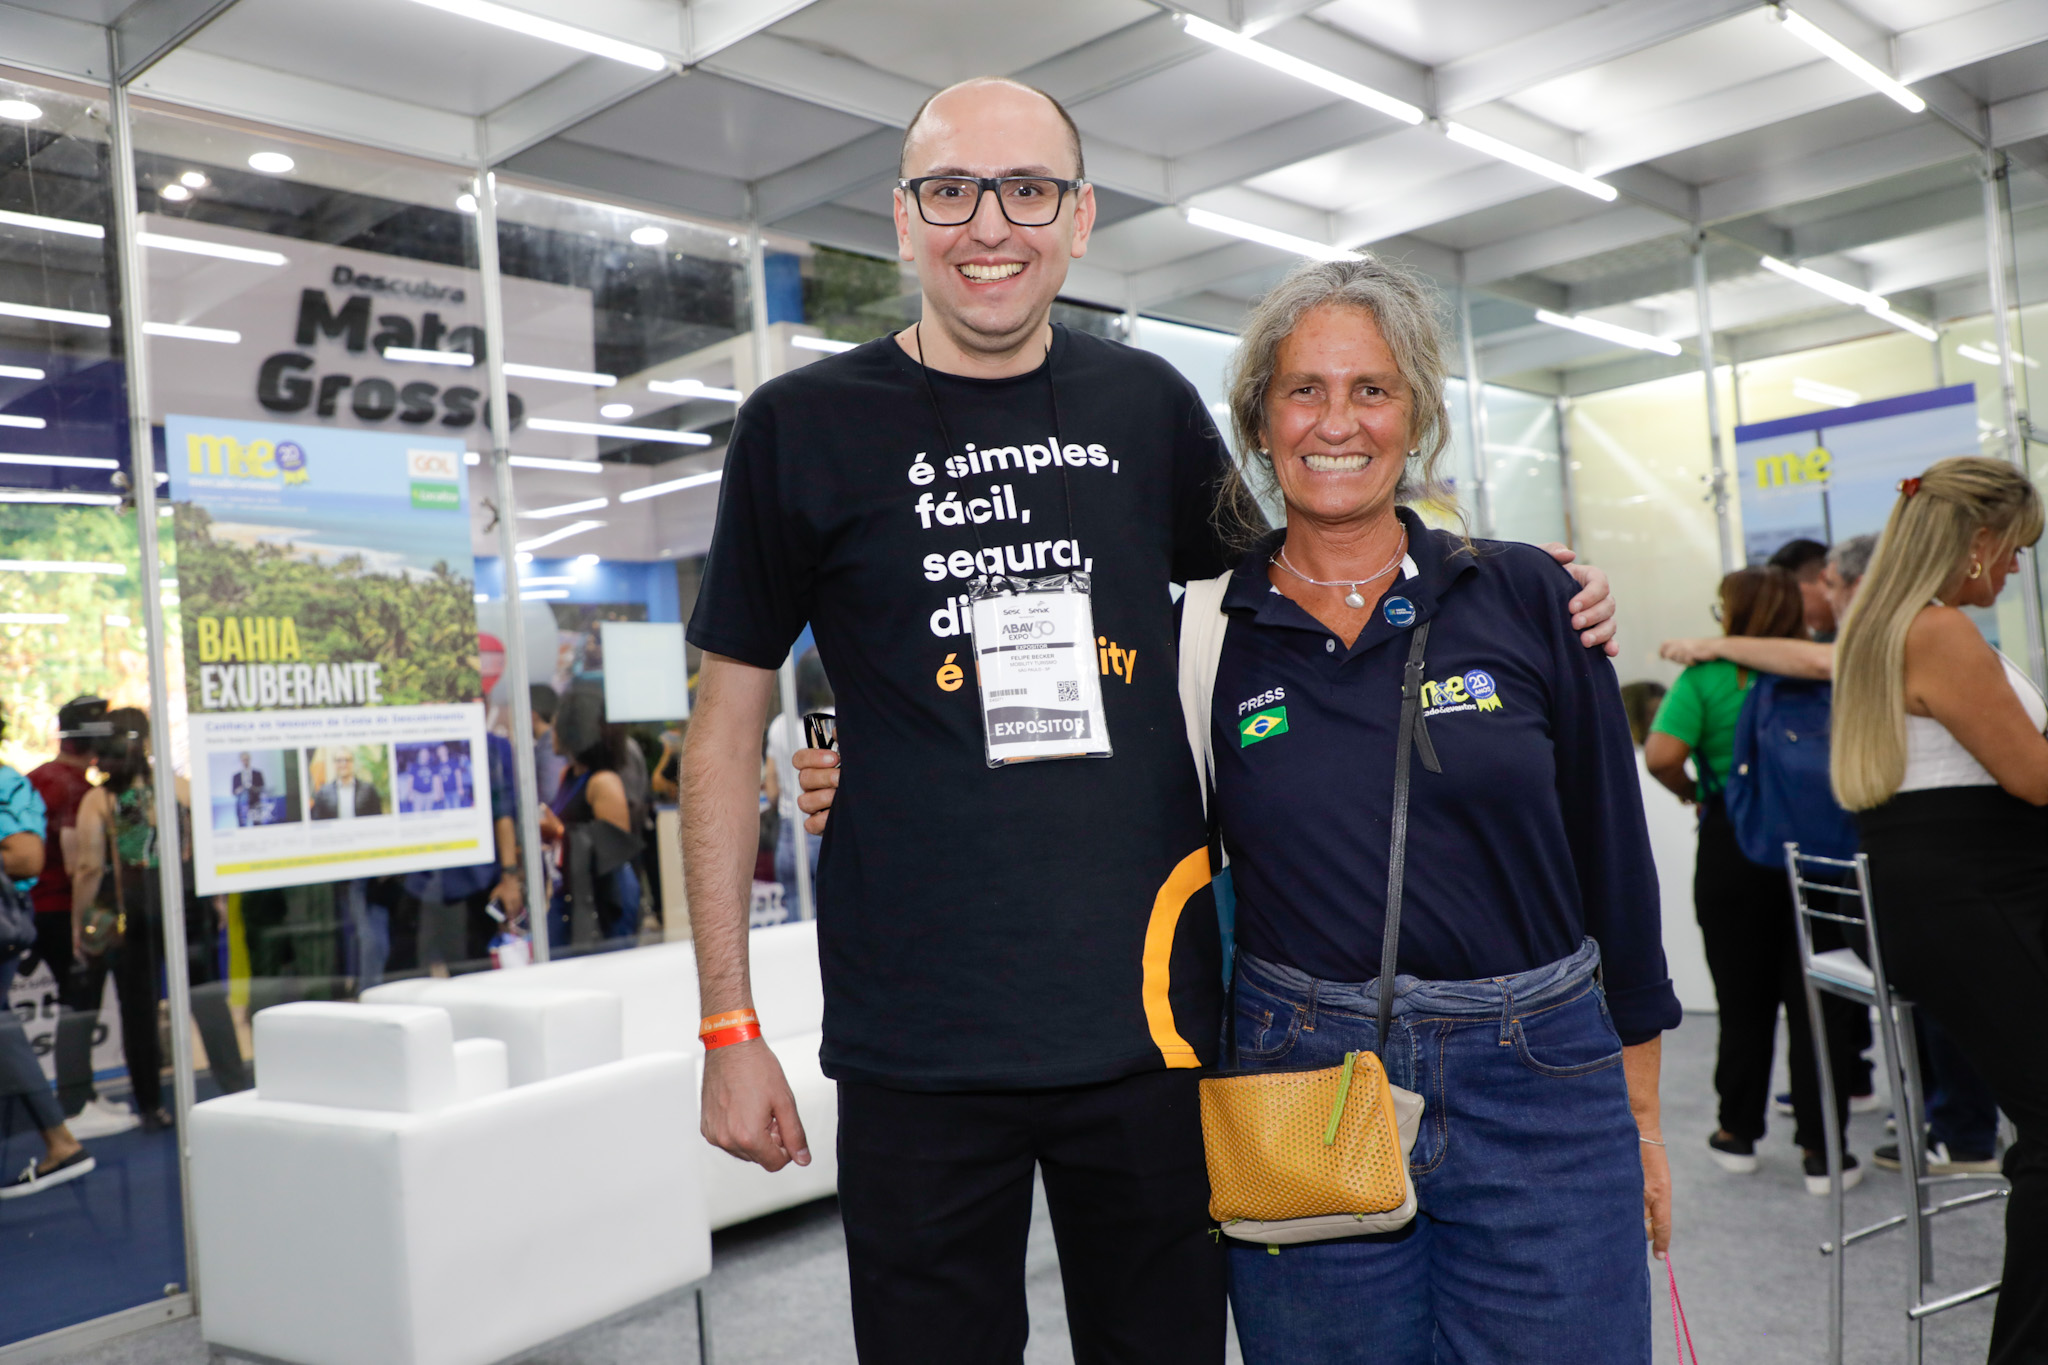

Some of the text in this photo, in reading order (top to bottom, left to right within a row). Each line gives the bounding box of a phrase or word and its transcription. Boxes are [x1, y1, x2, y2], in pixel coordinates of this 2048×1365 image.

[332, 264, 466, 303] Descubra
[296, 288, 488, 367] Mato
[257, 351, 524, 433] Grosso
[908, 437, 1119, 486] é simples,
[915, 484, 1031, 529] fácil,
[923, 539, 1093, 585] segura,
[198, 616, 301, 662] BAHIA
[1002, 622, 1034, 635] ABAV
[1008, 633, 1029, 641] EXPO
[200, 662, 384, 709] EXUBERANTE
[936, 653, 964, 692] é
[1469, 674, 1489, 690] 20
[1474, 685, 1491, 695] ANOS
[1238, 686, 1286, 716] PRESS
[994, 718, 1085, 738] EXPOSITOR
